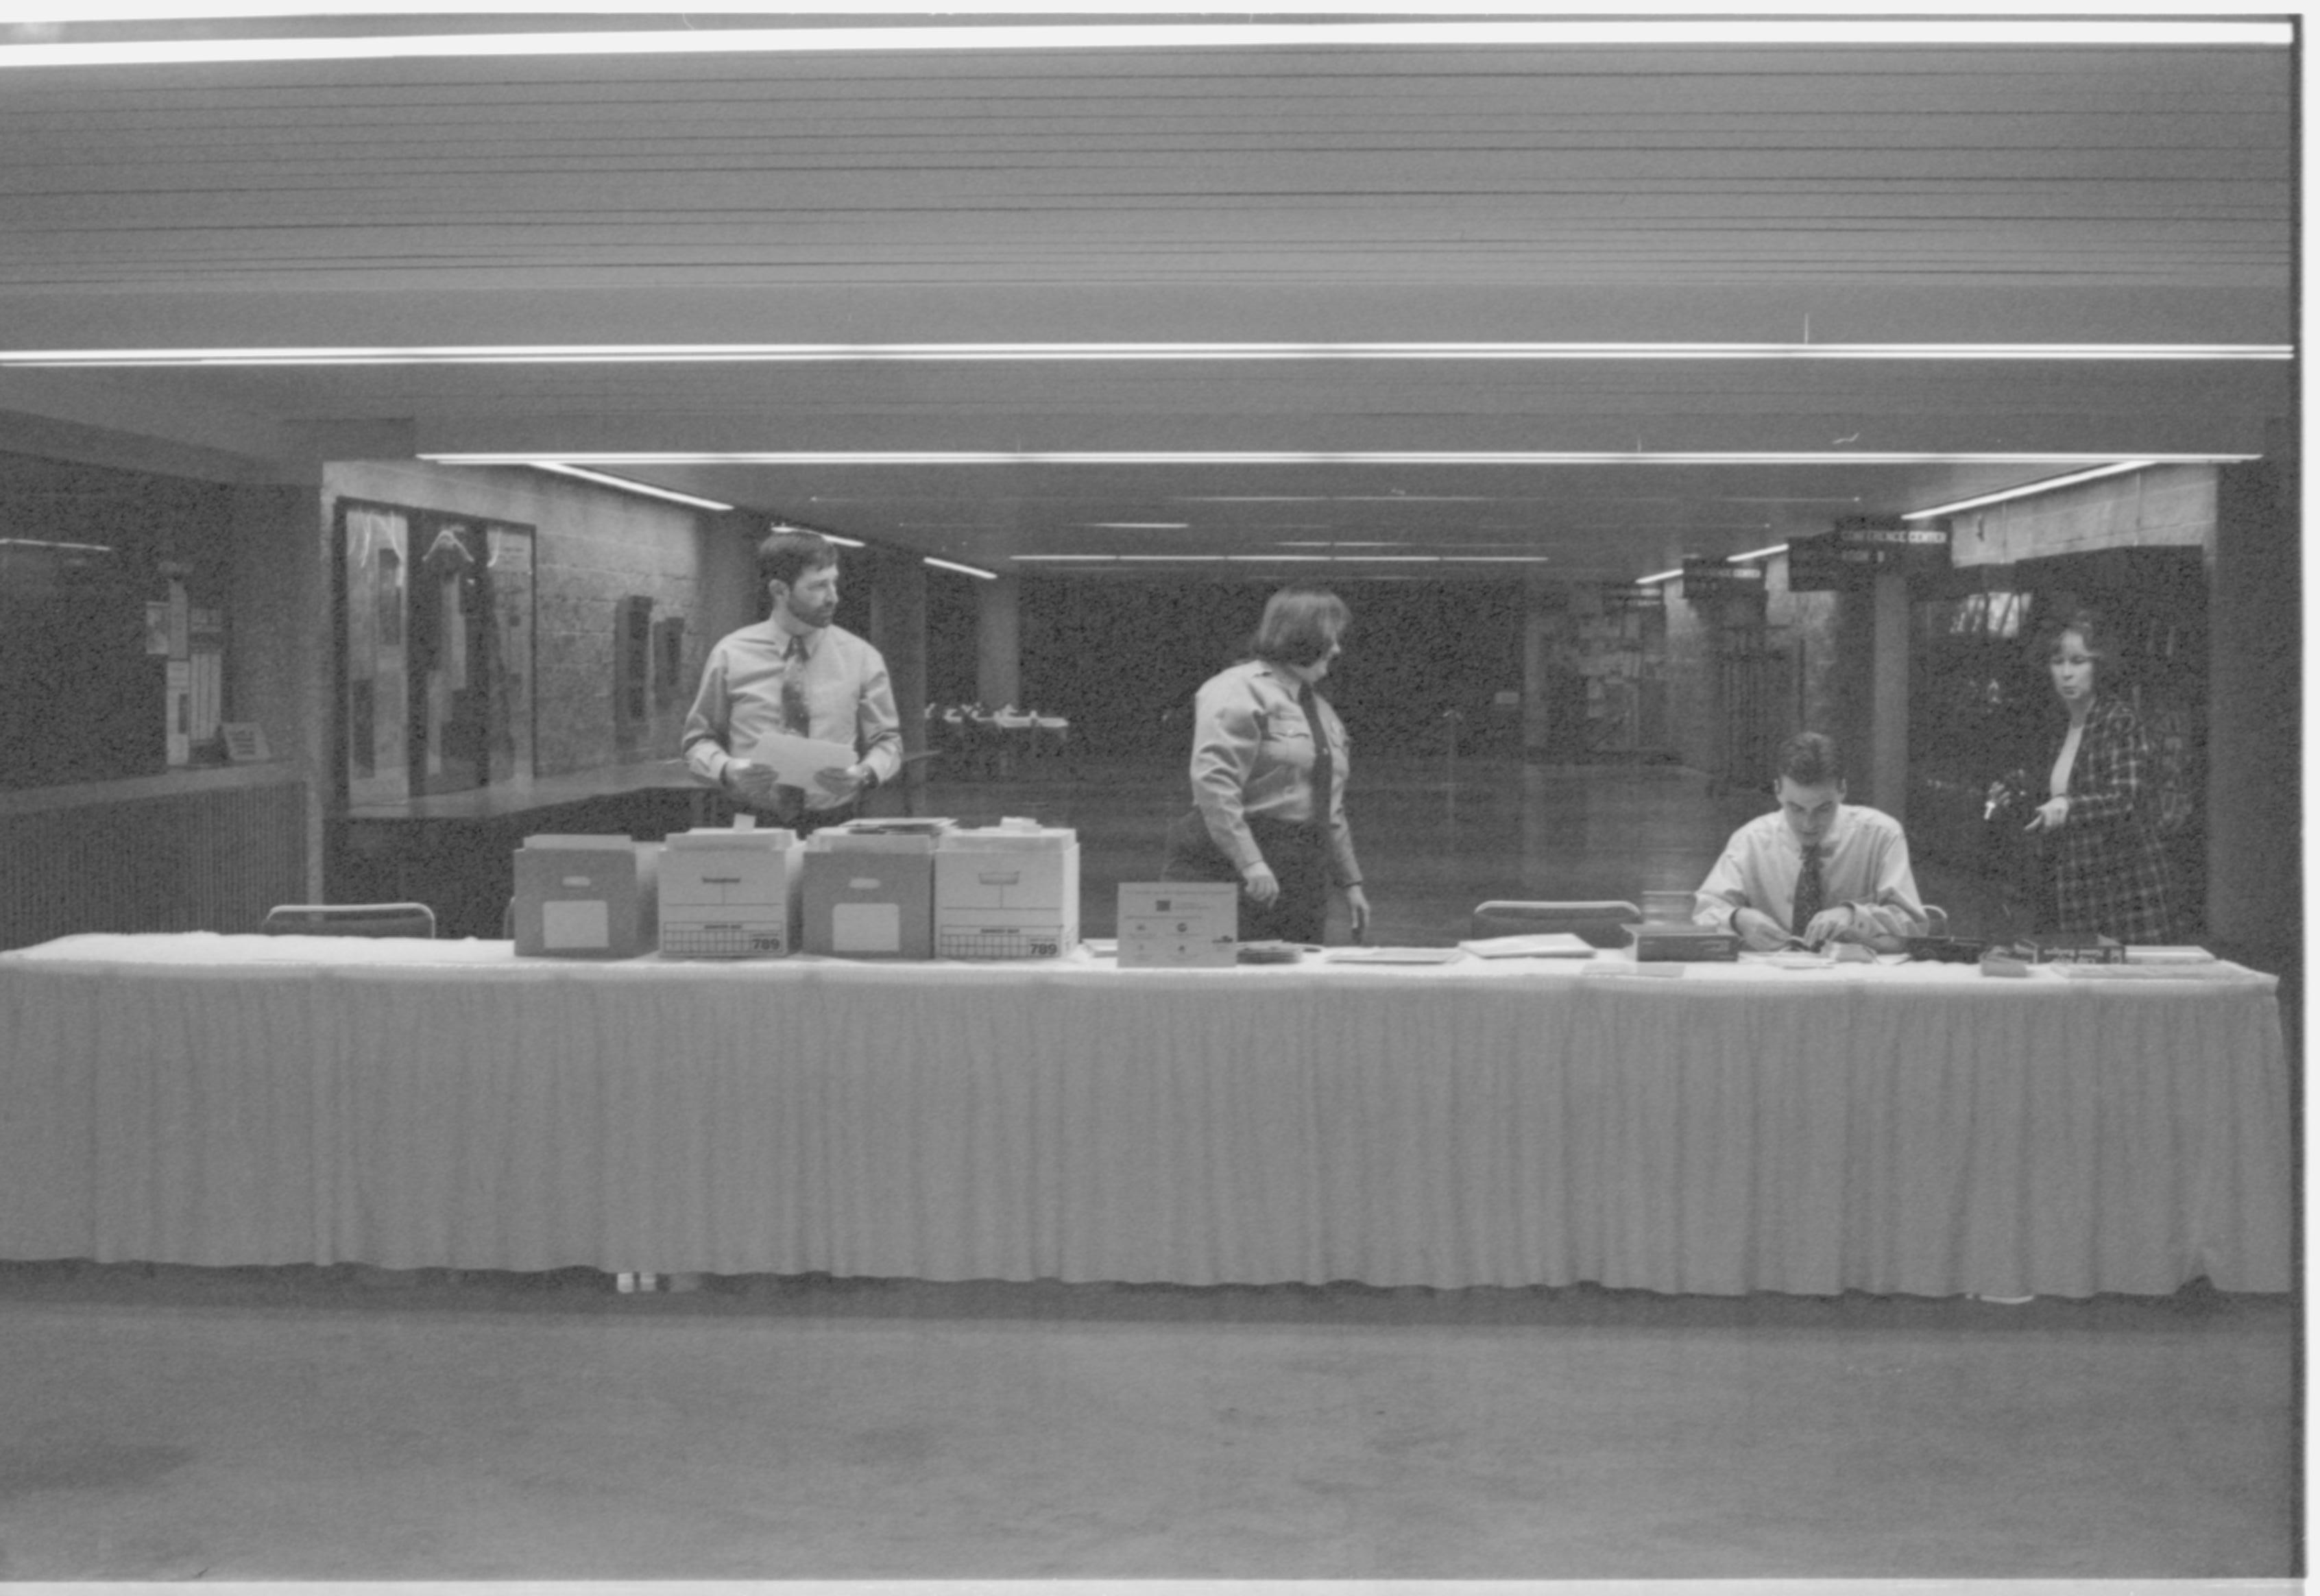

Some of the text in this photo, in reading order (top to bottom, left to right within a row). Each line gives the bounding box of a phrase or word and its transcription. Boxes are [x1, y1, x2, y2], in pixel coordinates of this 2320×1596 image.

[1908, 531, 1946, 543] CENTER
[752, 938, 780, 950] 789
[1030, 943, 1057, 955] 789
